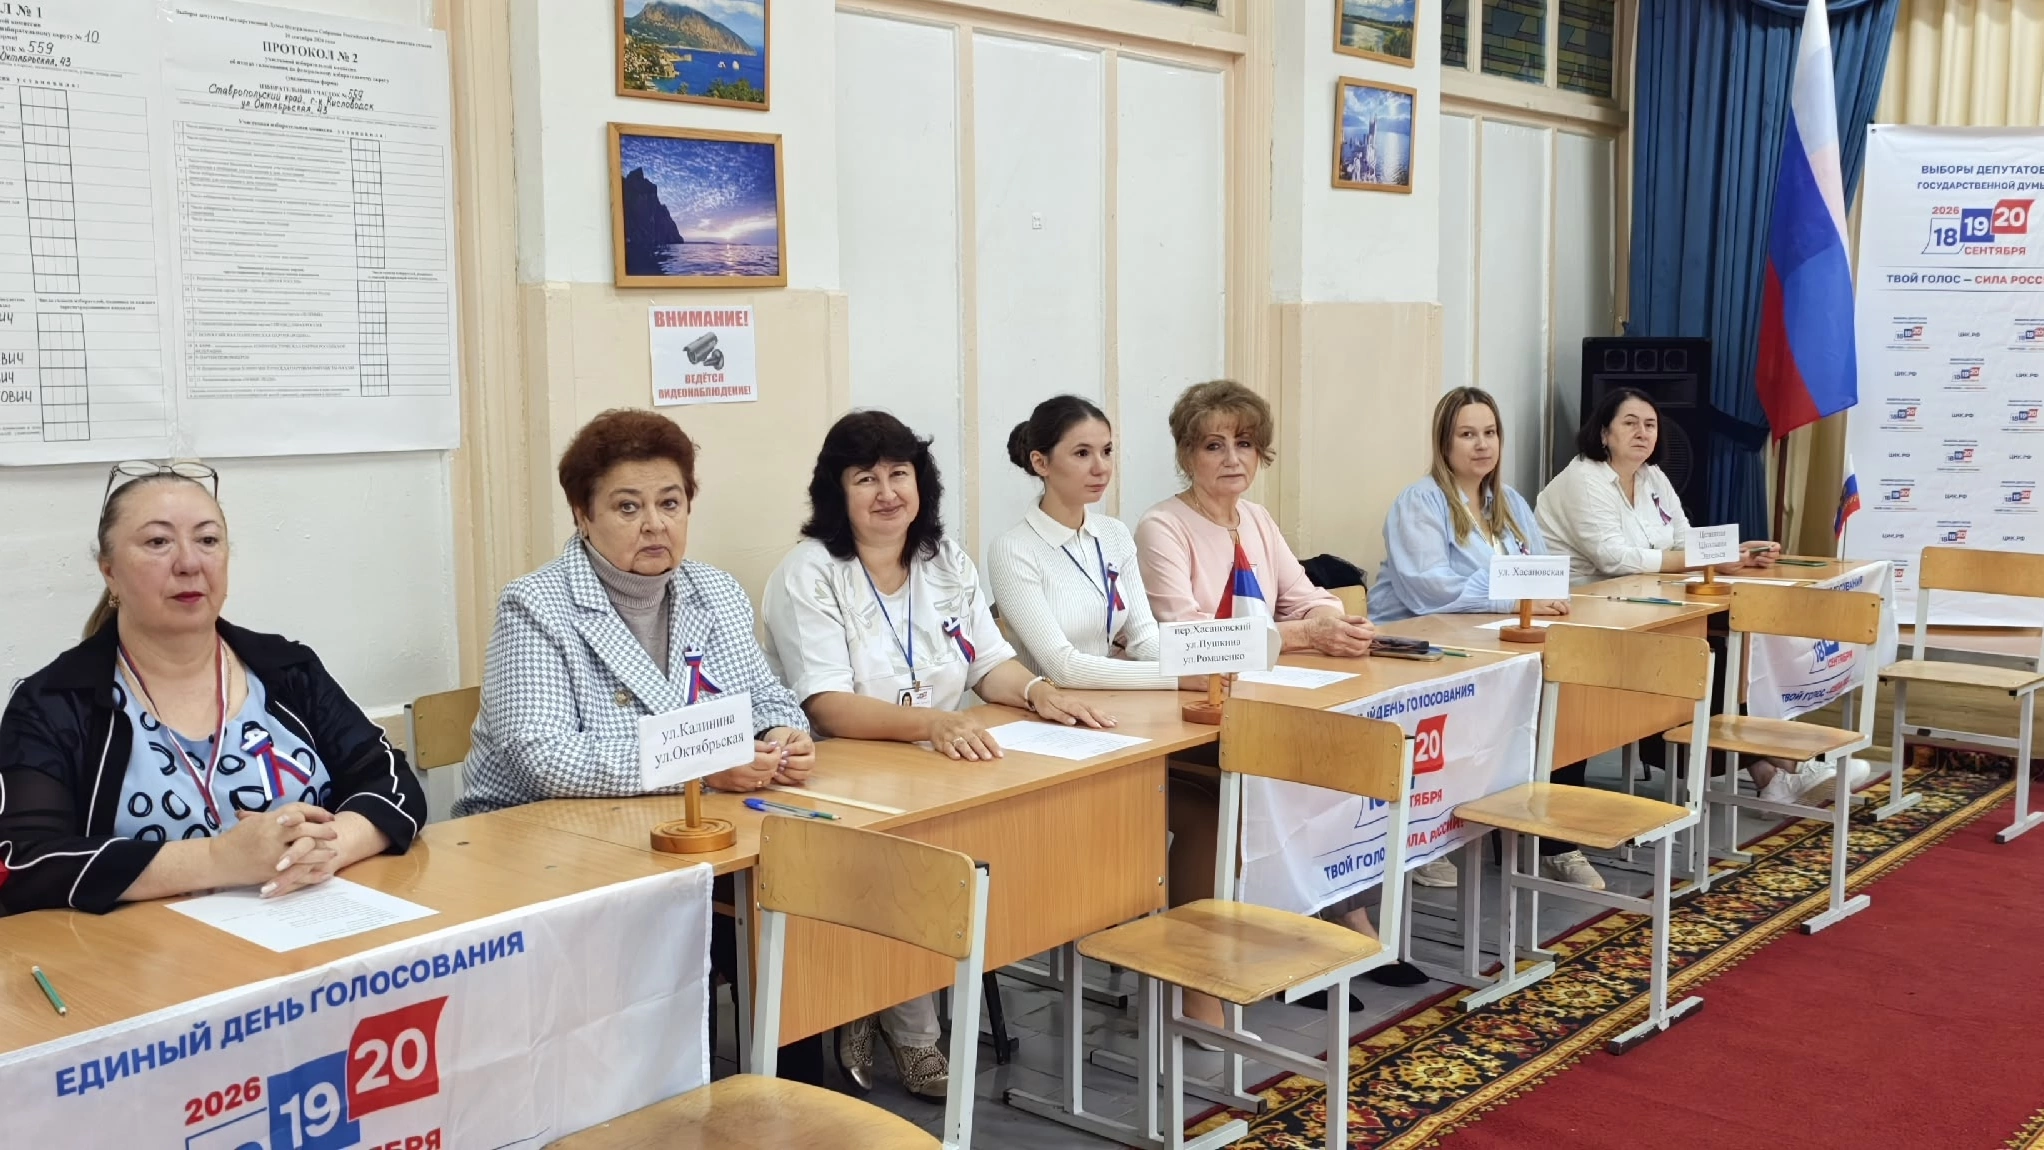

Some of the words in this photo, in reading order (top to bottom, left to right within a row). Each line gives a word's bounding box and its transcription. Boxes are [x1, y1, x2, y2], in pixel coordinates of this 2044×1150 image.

[84, 29, 100, 43] 10
[27, 40, 54, 55] 559
[263, 40, 334, 60] ПРОТОКОЛ
[336, 51, 350, 62] №
[352, 53, 358, 63] 2
[1921, 165, 1974, 175] ВЫБОРЫ
[1976, 165, 2044, 175] ДЕПУТАТОВ
[1917, 180, 2015, 191] ГОСУДАРСТВЕННОЙ
[1931, 206, 1960, 215] 2026
[1933, 227, 1958, 247] 18
[1964, 216, 1989, 237] 19
[1994, 206, 2026, 227] 20
[1964, 246, 2026, 256] СЕНТЯБРЯ
[1887, 272, 1919, 283] ТВОЙ
[1921, 275, 1961, 284] ГОЛОС
[1975, 275, 2008, 285] СИЛА
[2010, 275, 2044, 285] РОСС
[654, 310, 749, 327] ВНИМАНИЕ!
[685, 372, 724, 384] ВЕДЁТСЯ
[658, 386, 751, 399] ВИДЕОНАБЛЮДЕНИЕ!
[1512, 567, 1564, 577] Хасановская
[1185, 639, 1241, 651] ул.Пушкина
[1183, 653, 1245, 666] ул.Романенко
[1375, 700, 1405, 720] ДЕНЬ
[1406, 683, 1475, 712] ГОЛОСОВАНИЯ
[661, 713, 735, 745] ул.Калинина
[654, 732, 744, 769] ул.Октябрьская
[1414, 728, 1440, 763] 20
[1409, 789, 1442, 808] ТЯБРЯ
[1323, 854, 1354, 881] ТВОЙ
[1356, 846, 1385, 870] ГОЛО
[1407, 831, 1427, 847] ИЛА
[55, 1020, 212, 1097] ЕДИНЫЙ
[220, 997, 305, 1049] ДЕНЬ
[310, 930, 525, 1013] ГОЛОСОВАНИЯ
[279, 1081, 341, 1150] 19
[354, 1027, 428, 1095] 20
[184, 1076, 261, 1126] 2026
